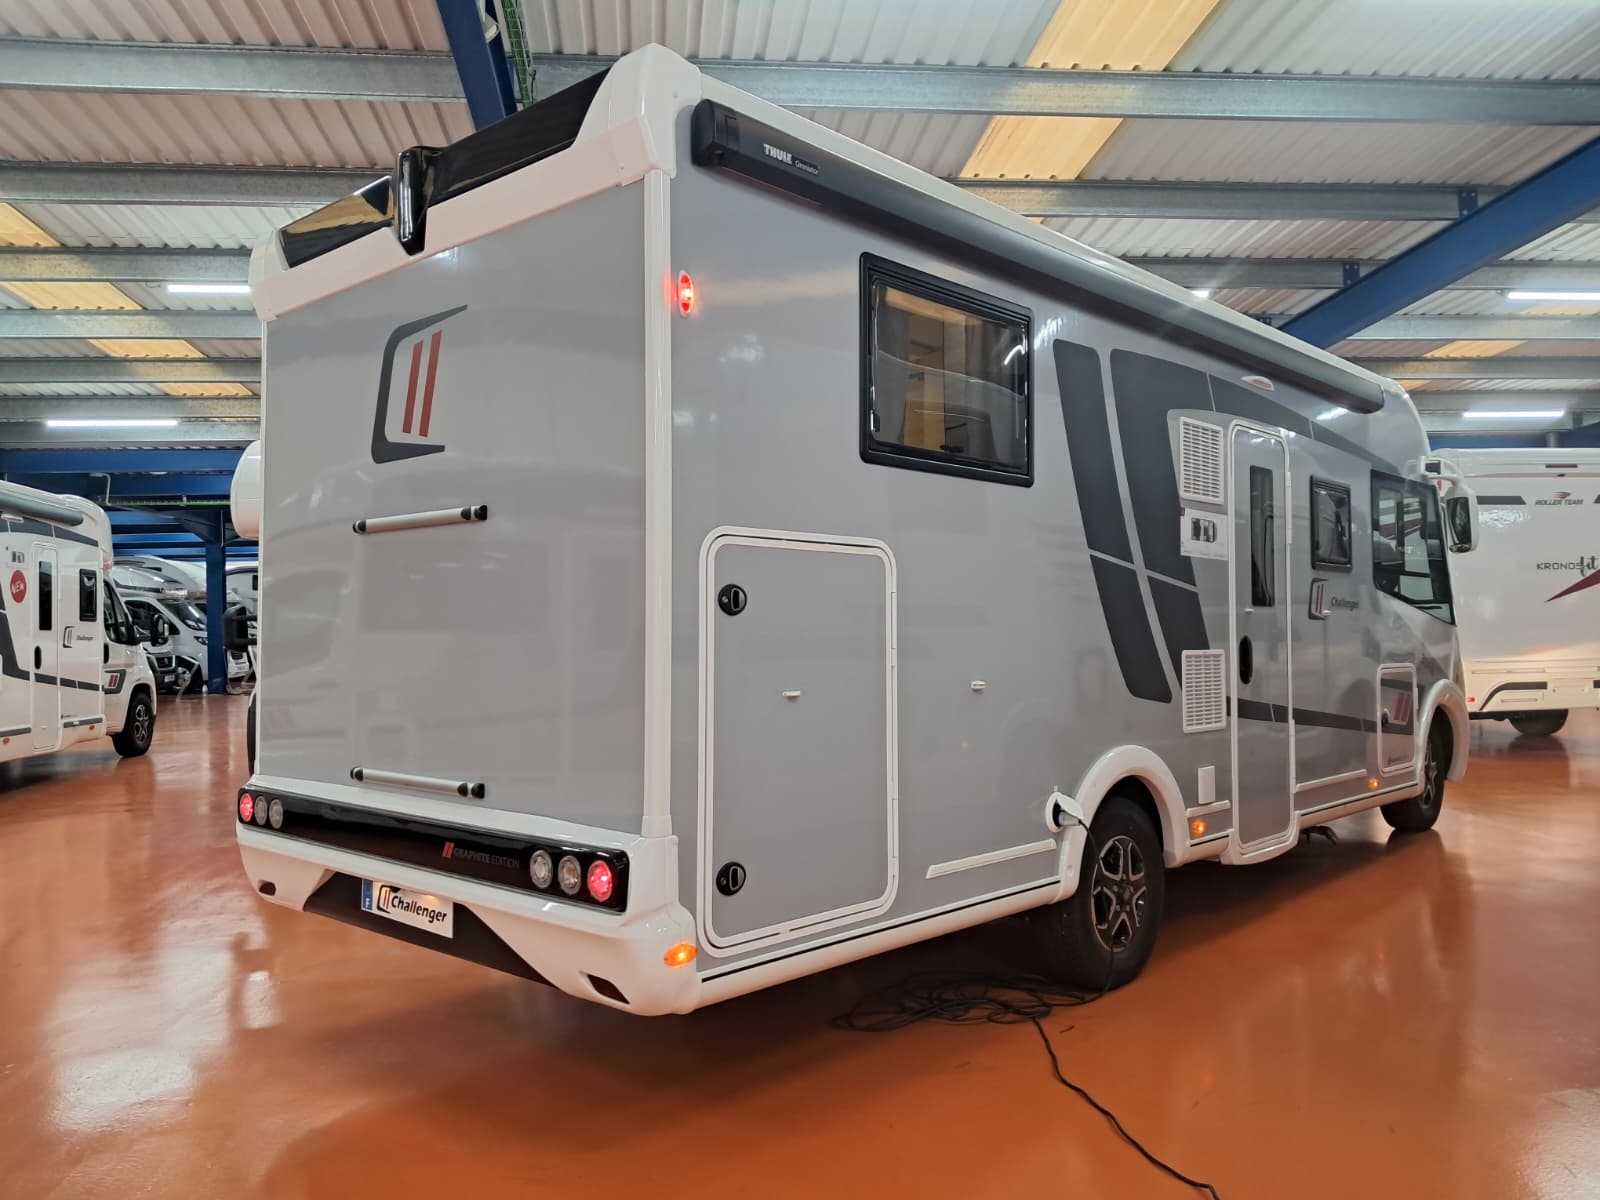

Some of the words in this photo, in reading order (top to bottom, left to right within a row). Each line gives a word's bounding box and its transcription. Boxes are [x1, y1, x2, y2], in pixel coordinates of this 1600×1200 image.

[763, 143, 793, 165] THULE
[491, 854, 520, 870] EDITION
[391, 895, 447, 924] Challenger
